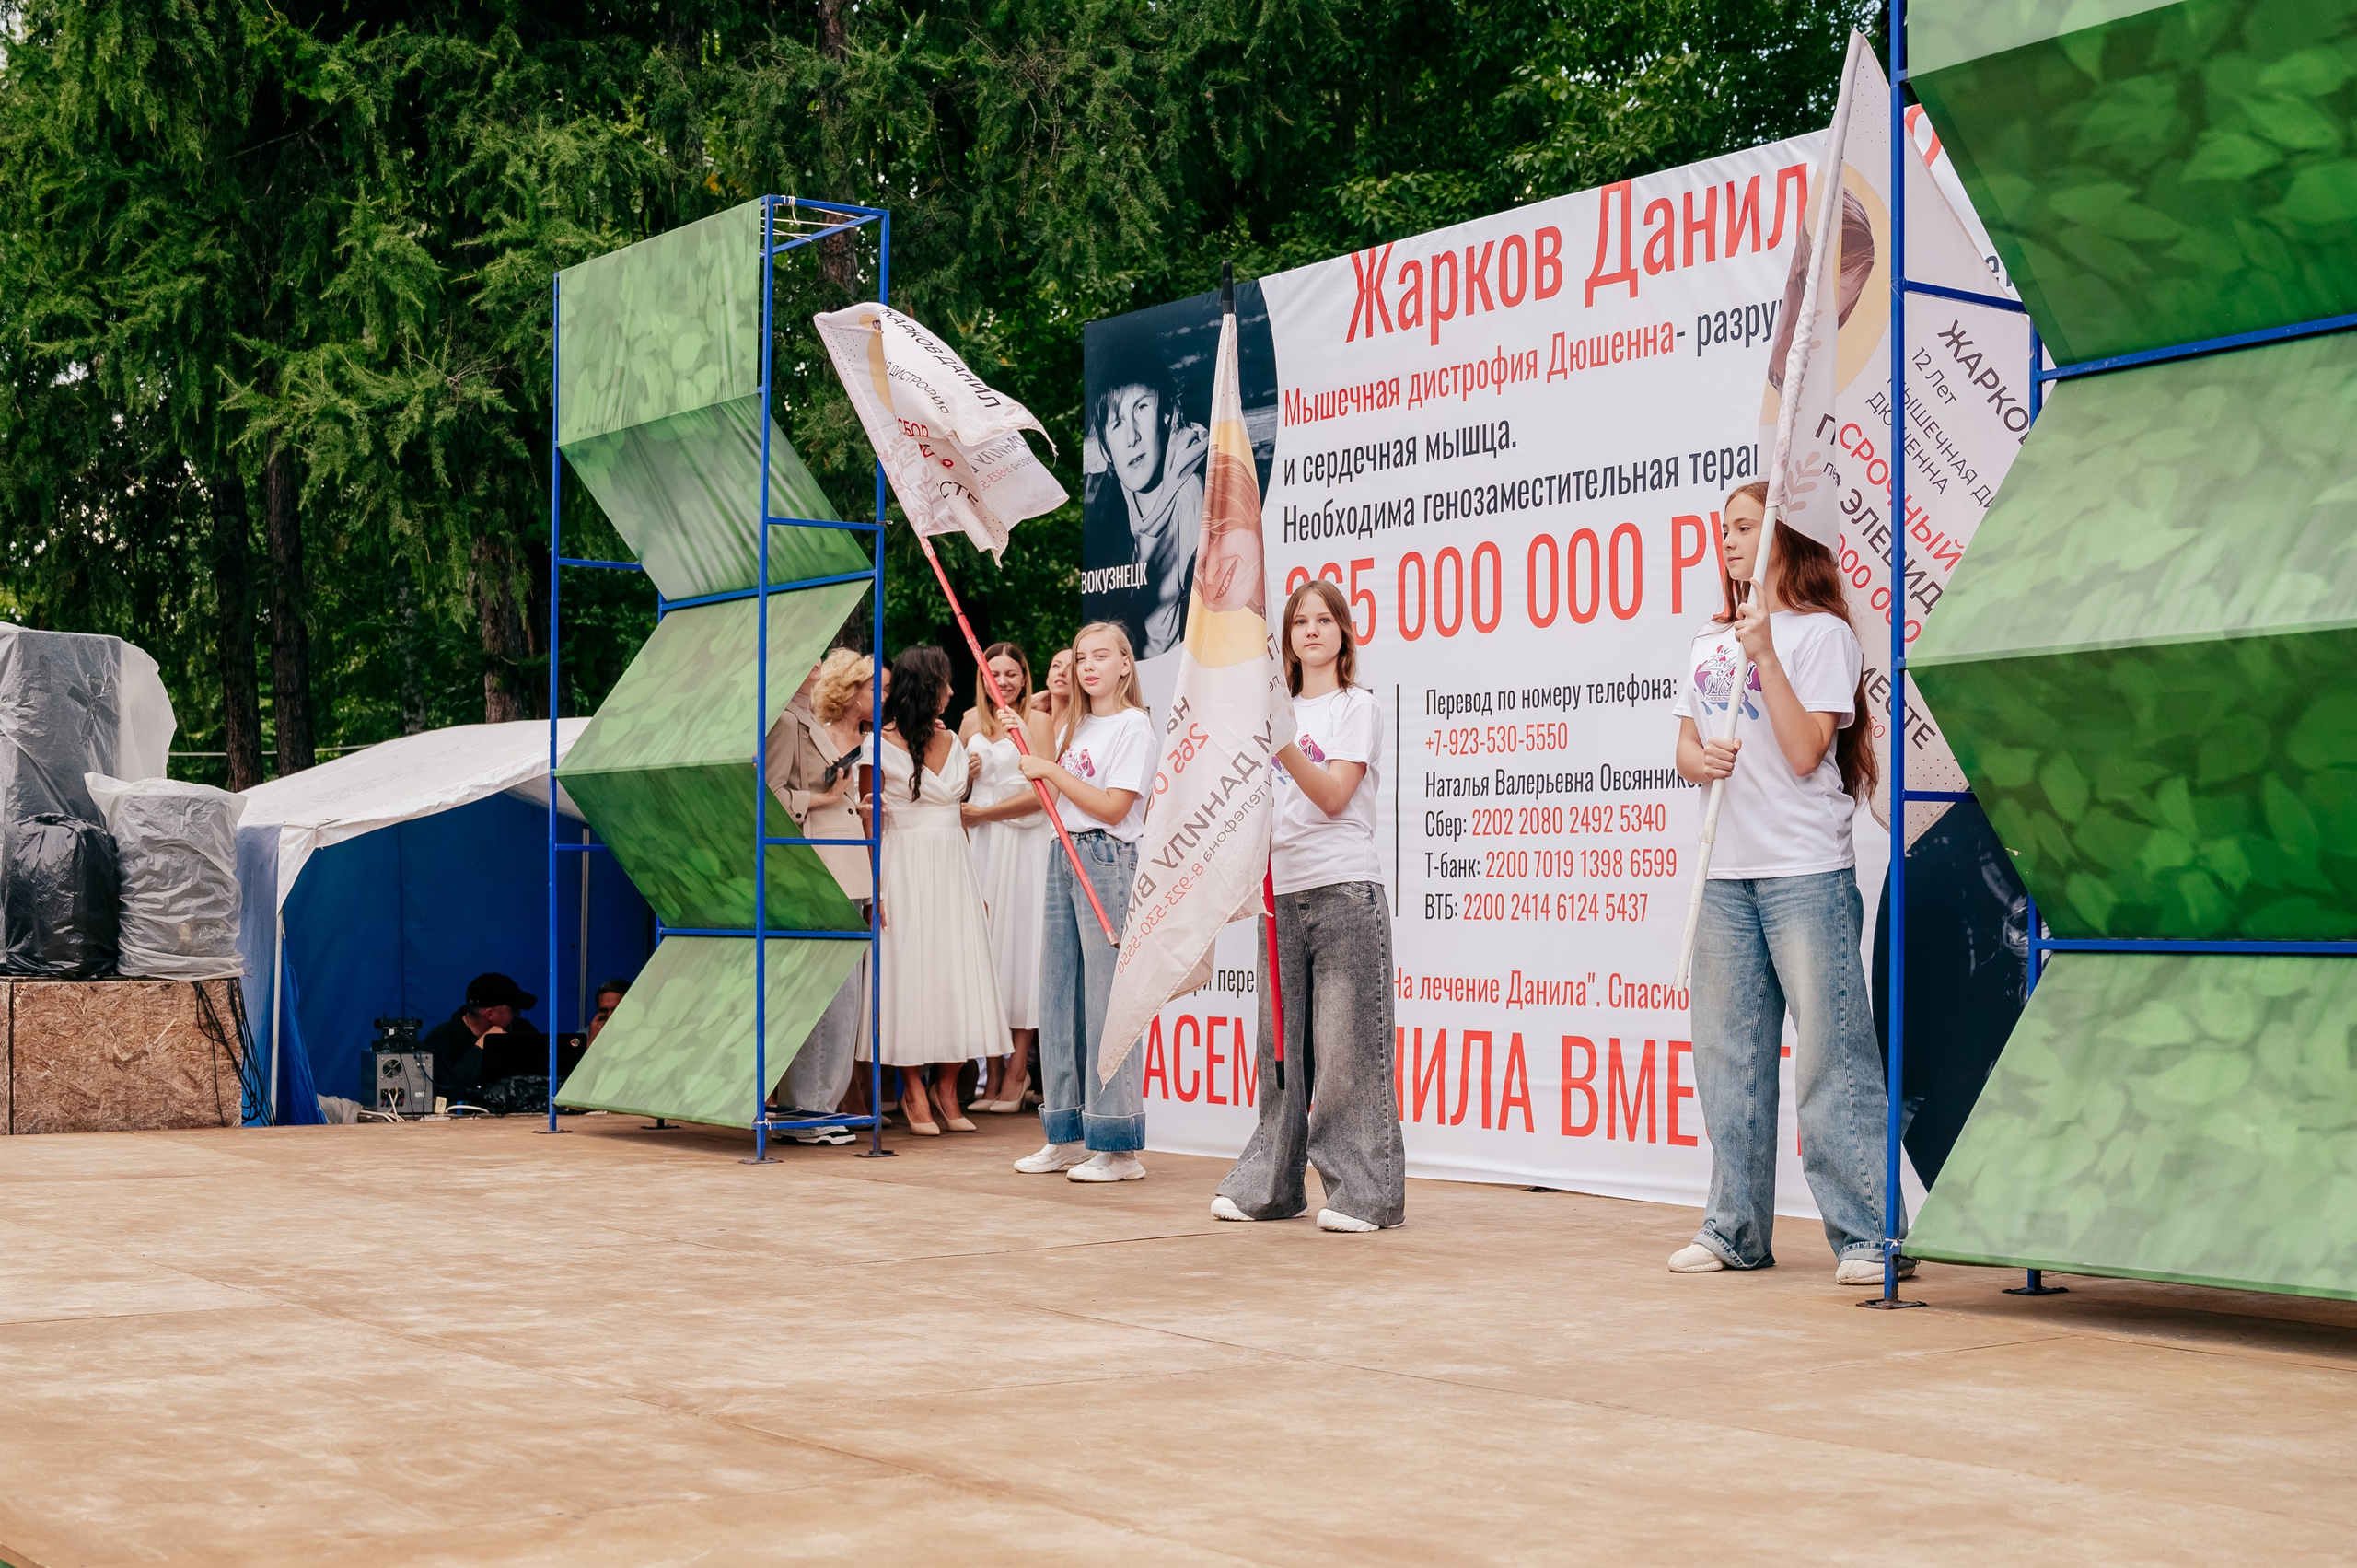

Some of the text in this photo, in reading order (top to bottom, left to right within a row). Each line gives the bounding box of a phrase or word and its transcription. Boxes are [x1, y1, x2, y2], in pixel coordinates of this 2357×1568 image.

[1346, 226, 1563, 346] Жарков
[932, 355, 1001, 407] ДАНИЛ
[1283, 376, 1401, 427] Мышечная
[1407, 345, 1538, 411] дистрофия
[1697, 299, 1783, 357] разру
[1911, 346, 1932, 372] 12
[1283, 420, 1517, 487] и сердечная мышца.
[1865, 391, 1948, 494] ДЮЕННА
[1887, 378, 1979, 486] ЫШЕЧНАЯ
[1283, 497, 1415, 543] Необходима
[1423, 456, 1679, 524] генозаместительная
[1081, 562, 1148, 595] ВОКУЗНЕЦК
[1397, 540, 1503, 642] 000
[1526, 522, 1643, 629] 000
[1425, 688, 1492, 720] Перевод
[1497, 690, 1516, 712] по
[1522, 683, 1580, 713] номеру
[1586, 673, 1677, 708] телефона:
[1425, 722, 1569, 756] +7-923-530-5550
[1425, 763, 1702, 799] Наталья Валерьевна Овсянник
[1425, 803, 1666, 842] Сбер: 2202 2080 2492 5340
[1425, 848, 1677, 879] Т-банк: 2200 7019 1398 6599
[1425, 893, 1648, 922] ВТБ: 2200 2414 6124 5437
[1217, 969, 1258, 999] пере
[1419, 974, 1500, 1004] лечение
[1561, 1034, 1701, 1148] ВМЕ
